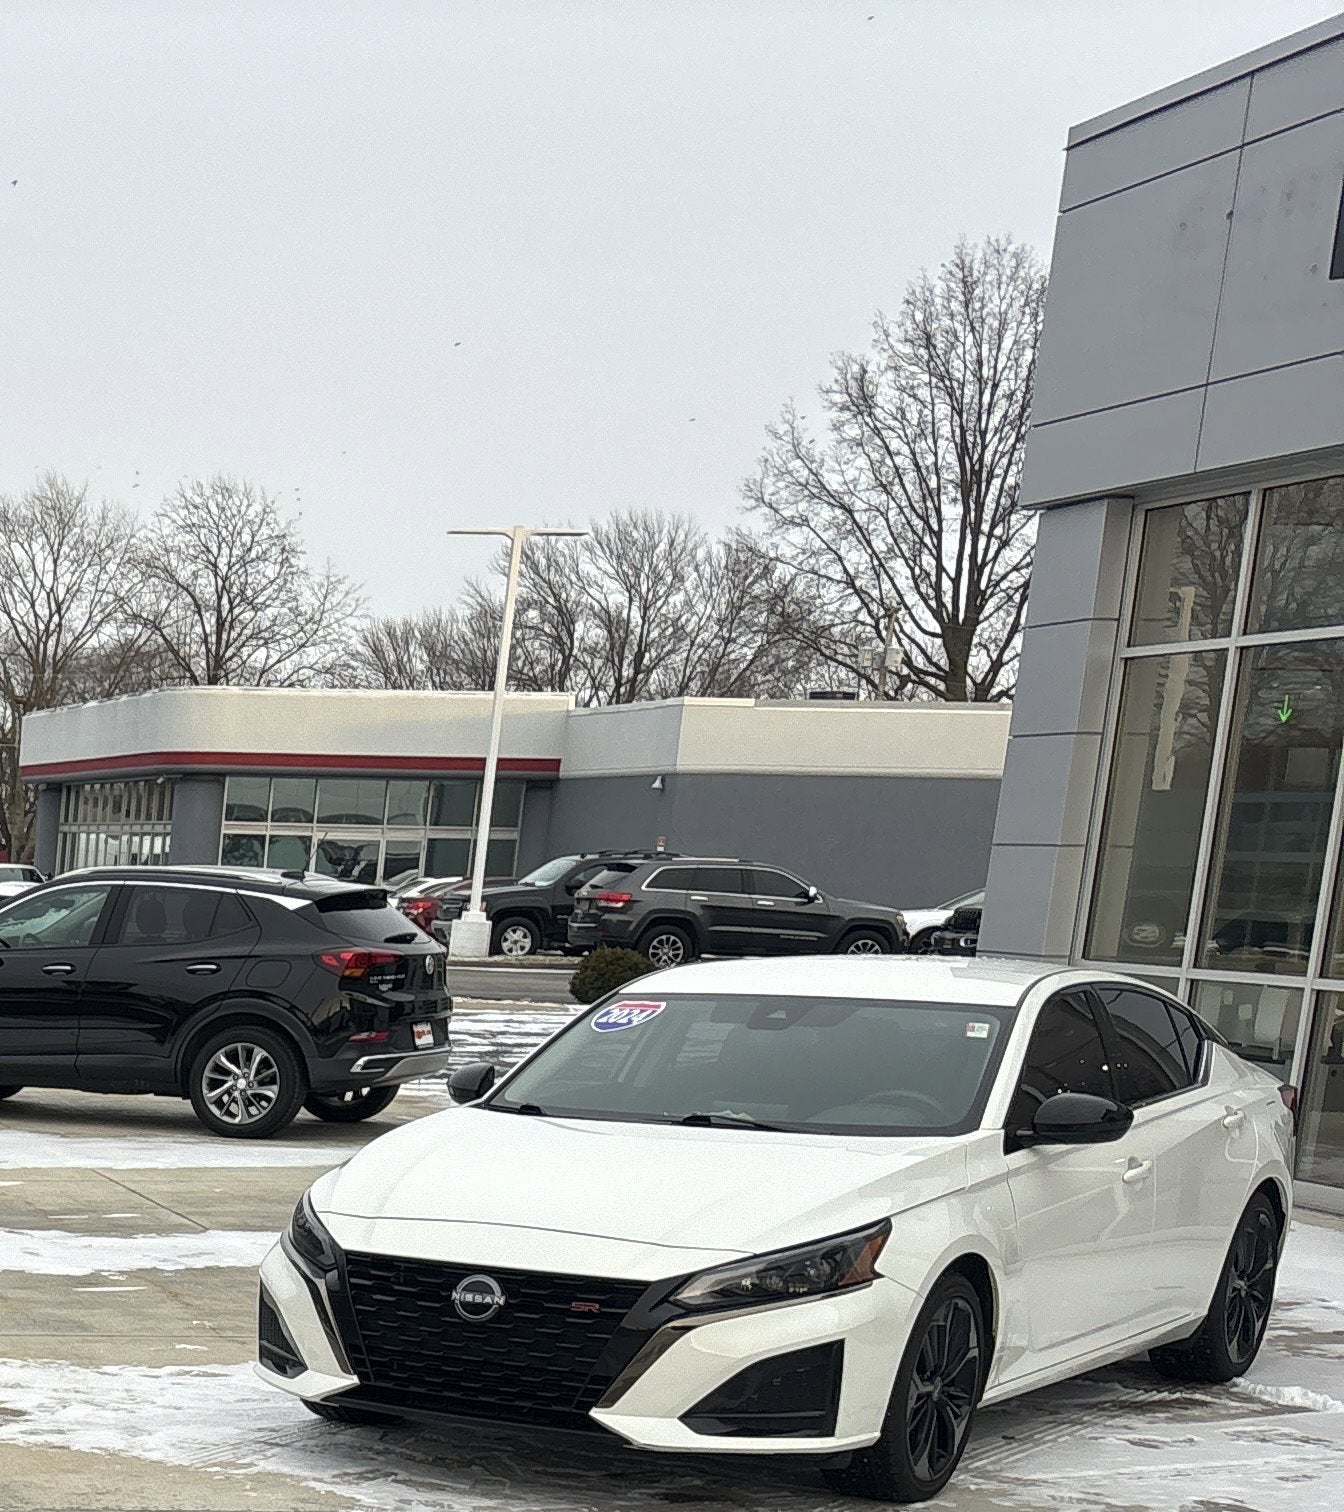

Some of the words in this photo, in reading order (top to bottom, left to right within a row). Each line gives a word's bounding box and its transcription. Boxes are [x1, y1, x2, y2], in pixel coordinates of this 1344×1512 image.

[595, 1008, 655, 1024] 2024
[451, 1289, 506, 1307] NISSAN
[570, 1301, 600, 1313] SR
